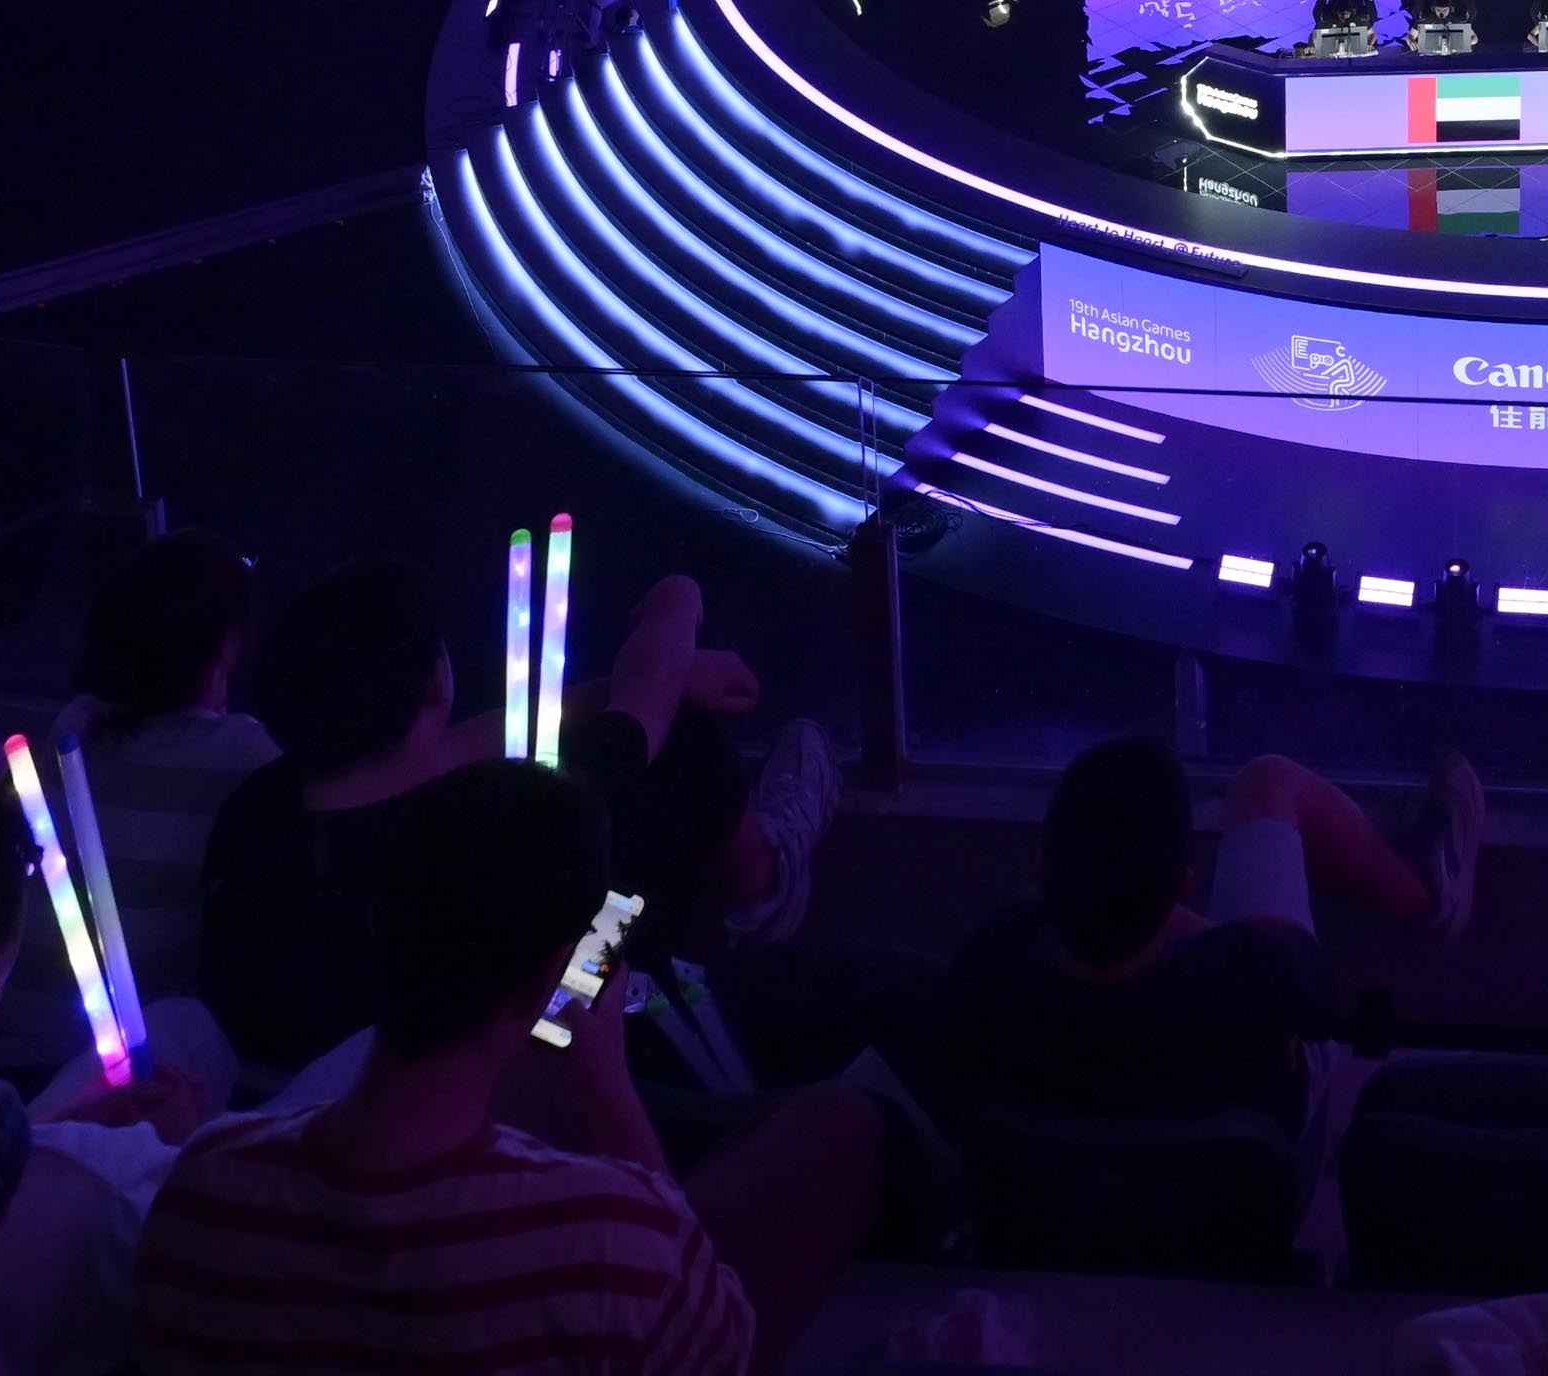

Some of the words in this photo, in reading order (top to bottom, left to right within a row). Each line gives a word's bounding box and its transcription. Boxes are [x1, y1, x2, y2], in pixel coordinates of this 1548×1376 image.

[1069, 298, 1098, 319] 19th
[1101, 308, 1139, 329] Asian
[1141, 318, 1191, 343] Games
[1070, 312, 1191, 364] Hangzhou
